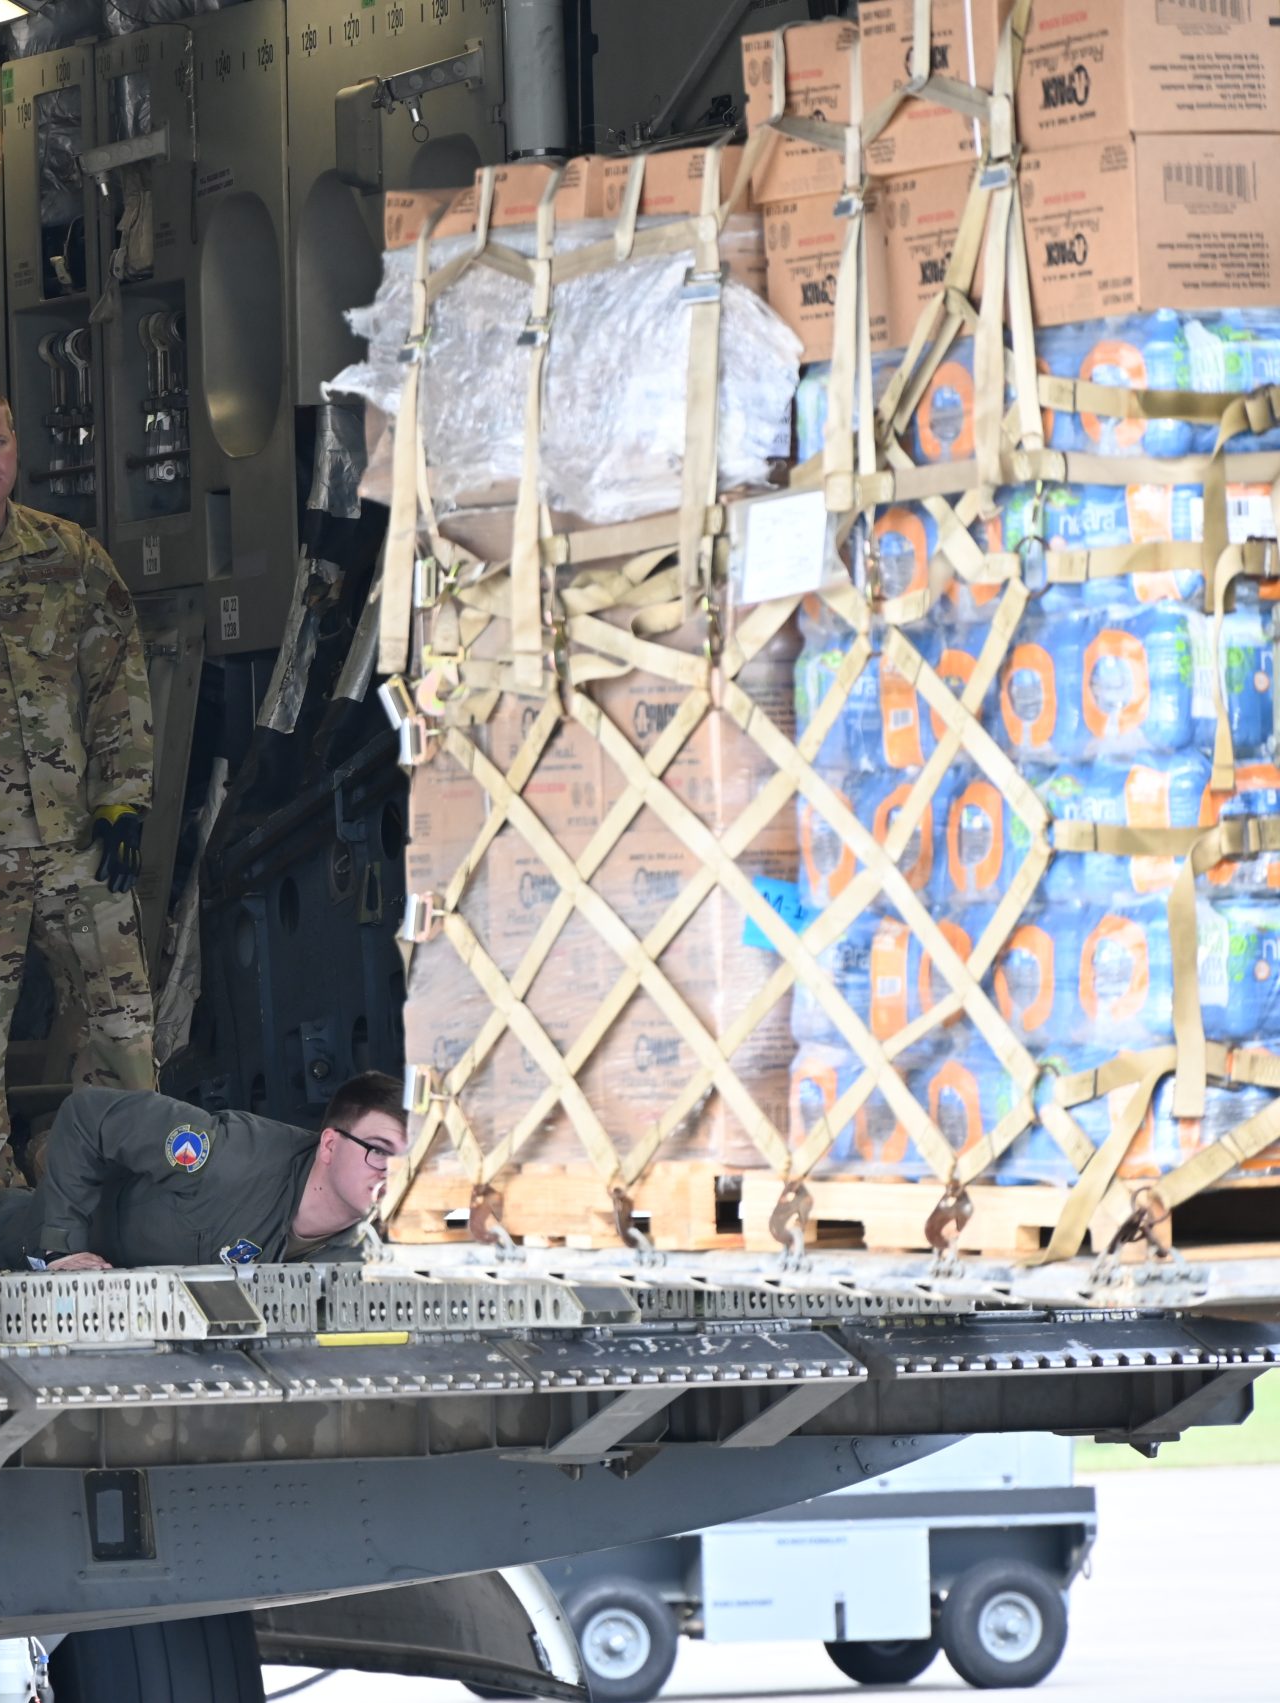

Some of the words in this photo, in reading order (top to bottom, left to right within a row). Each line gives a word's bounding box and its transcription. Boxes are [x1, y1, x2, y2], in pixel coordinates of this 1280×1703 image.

[388, 8, 404, 28] 1280
[301, 30, 317, 50] 1260
[343, 19, 359, 40] 1270
[215, 54, 231, 76] 1240
[257, 44, 273, 65] 1250
[55, 62, 70, 83] 1200
[17, 103, 31, 124] 1190
